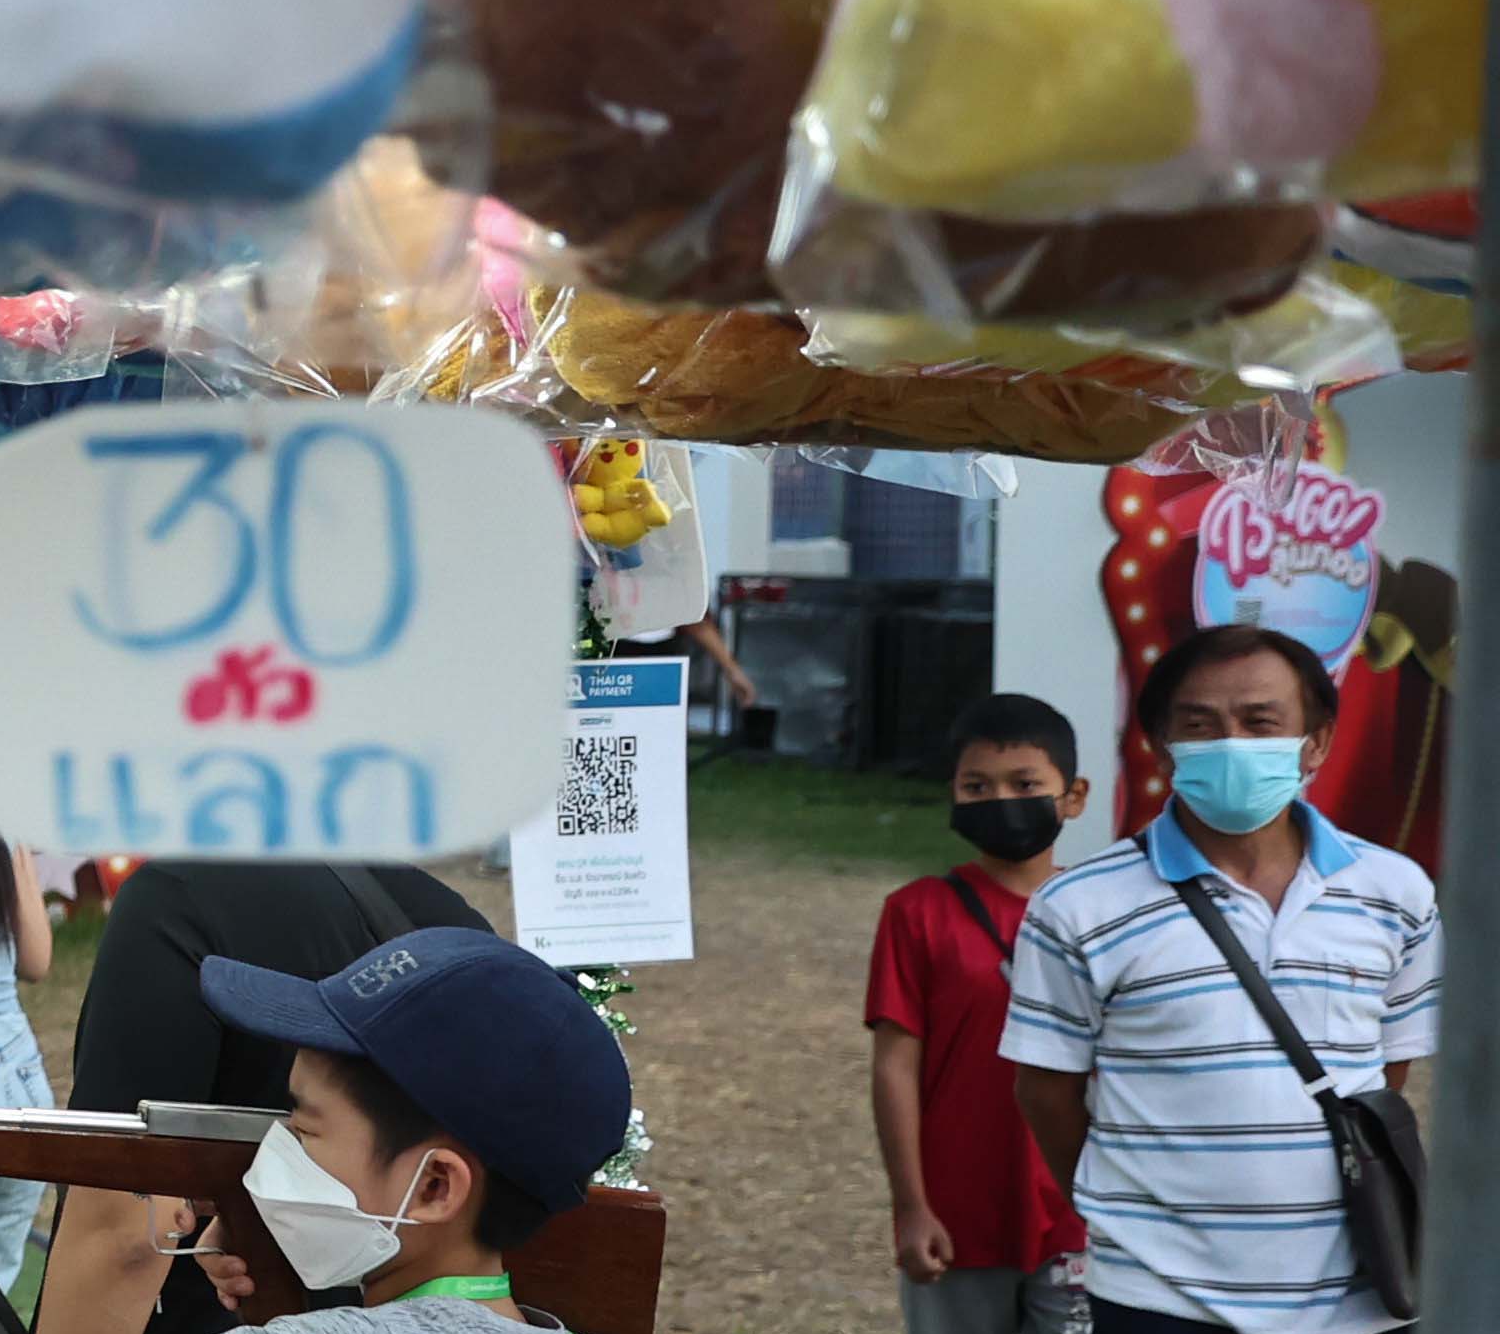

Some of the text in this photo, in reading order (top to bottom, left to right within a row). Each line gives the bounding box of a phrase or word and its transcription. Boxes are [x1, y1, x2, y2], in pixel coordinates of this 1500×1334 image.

[73, 421, 418, 667] 30
[182, 643, 318, 725] ตัว
[588, 686, 634, 698] PAYMENT
[589, 674, 634, 687] THAI QR
[53, 741, 439, 851] แลก
